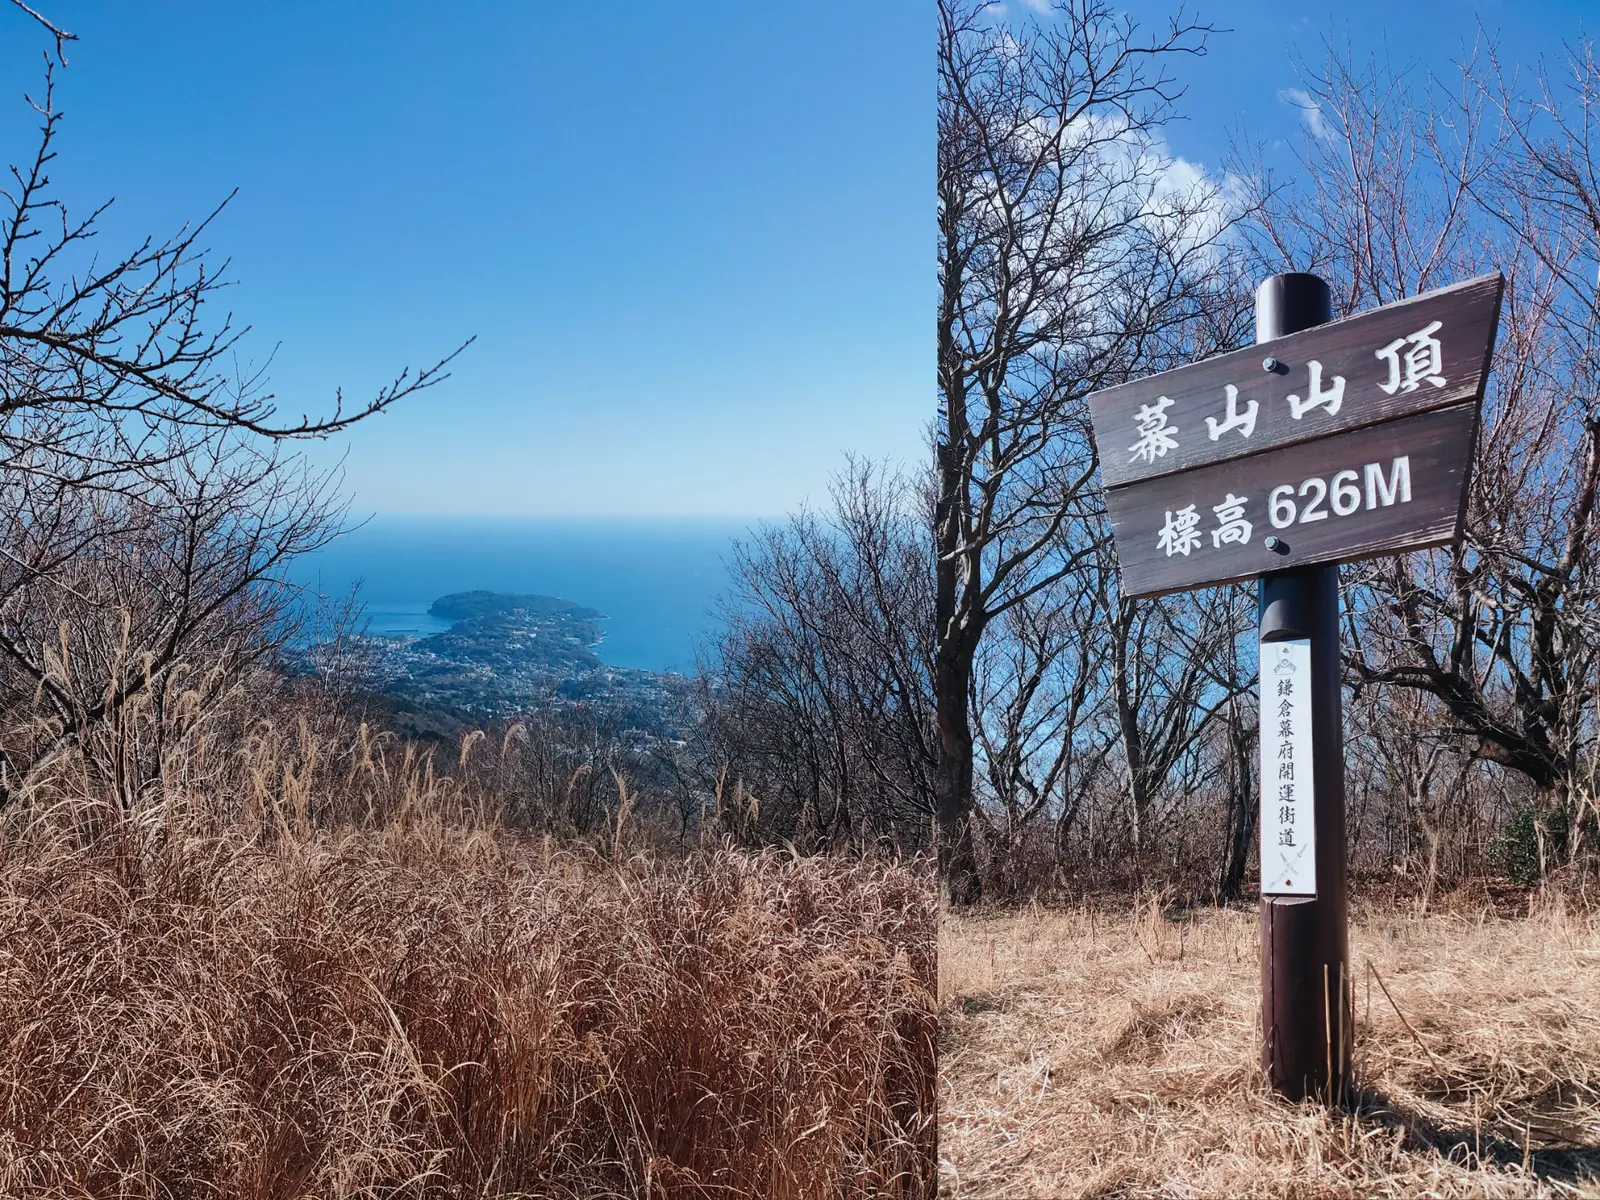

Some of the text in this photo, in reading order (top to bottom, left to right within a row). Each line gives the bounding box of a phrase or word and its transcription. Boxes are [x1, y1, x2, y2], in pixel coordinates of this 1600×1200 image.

[1127, 320, 1447, 465] 幕山山頂
[1277, 678, 1297, 848] 鎌倉幕府開運街道
